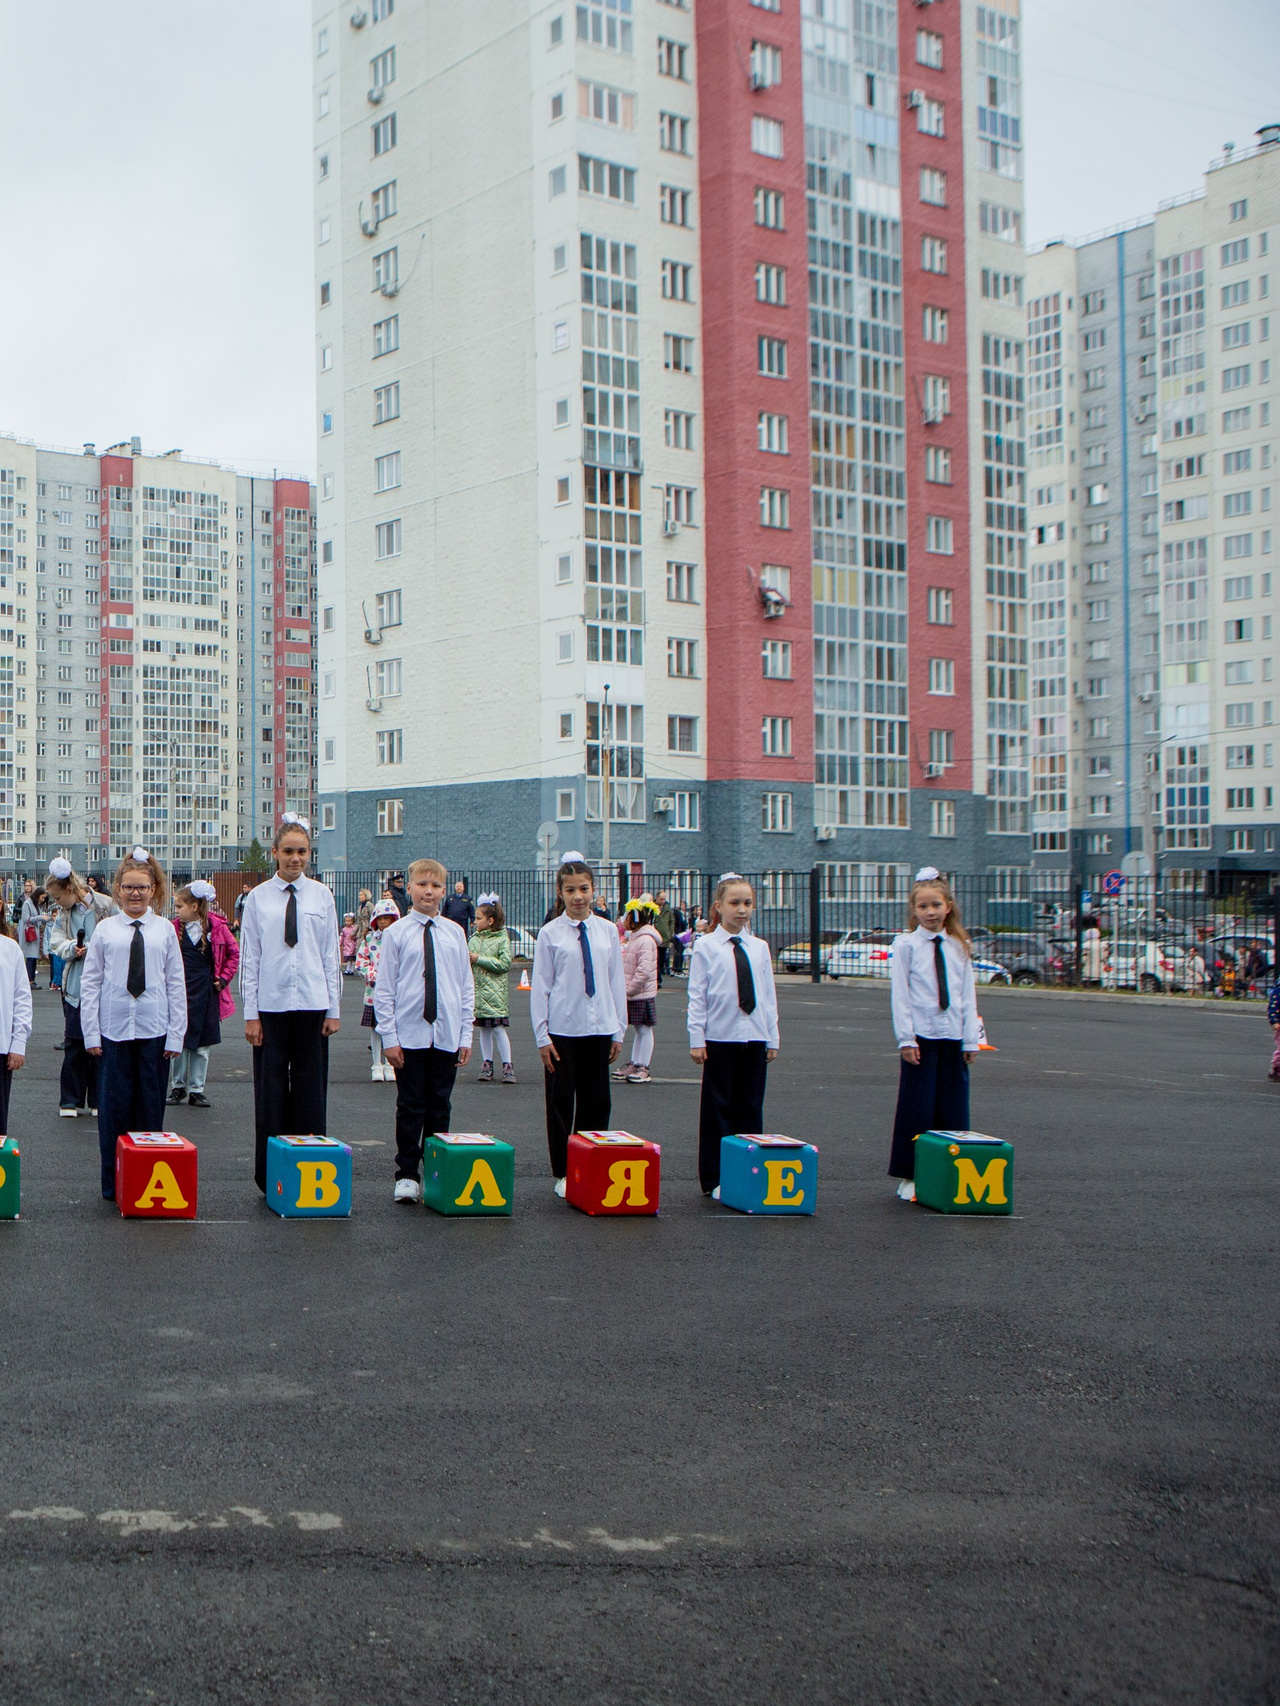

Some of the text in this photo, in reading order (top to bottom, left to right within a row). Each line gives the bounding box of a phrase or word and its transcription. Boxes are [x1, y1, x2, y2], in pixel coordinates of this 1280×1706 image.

[134, 1161, 189, 1209] А
[295, 1161, 340, 1208] В
[601, 1160, 649, 1207] Я
[763, 1159, 804, 1206] Е
[954, 1158, 1008, 1204] М
